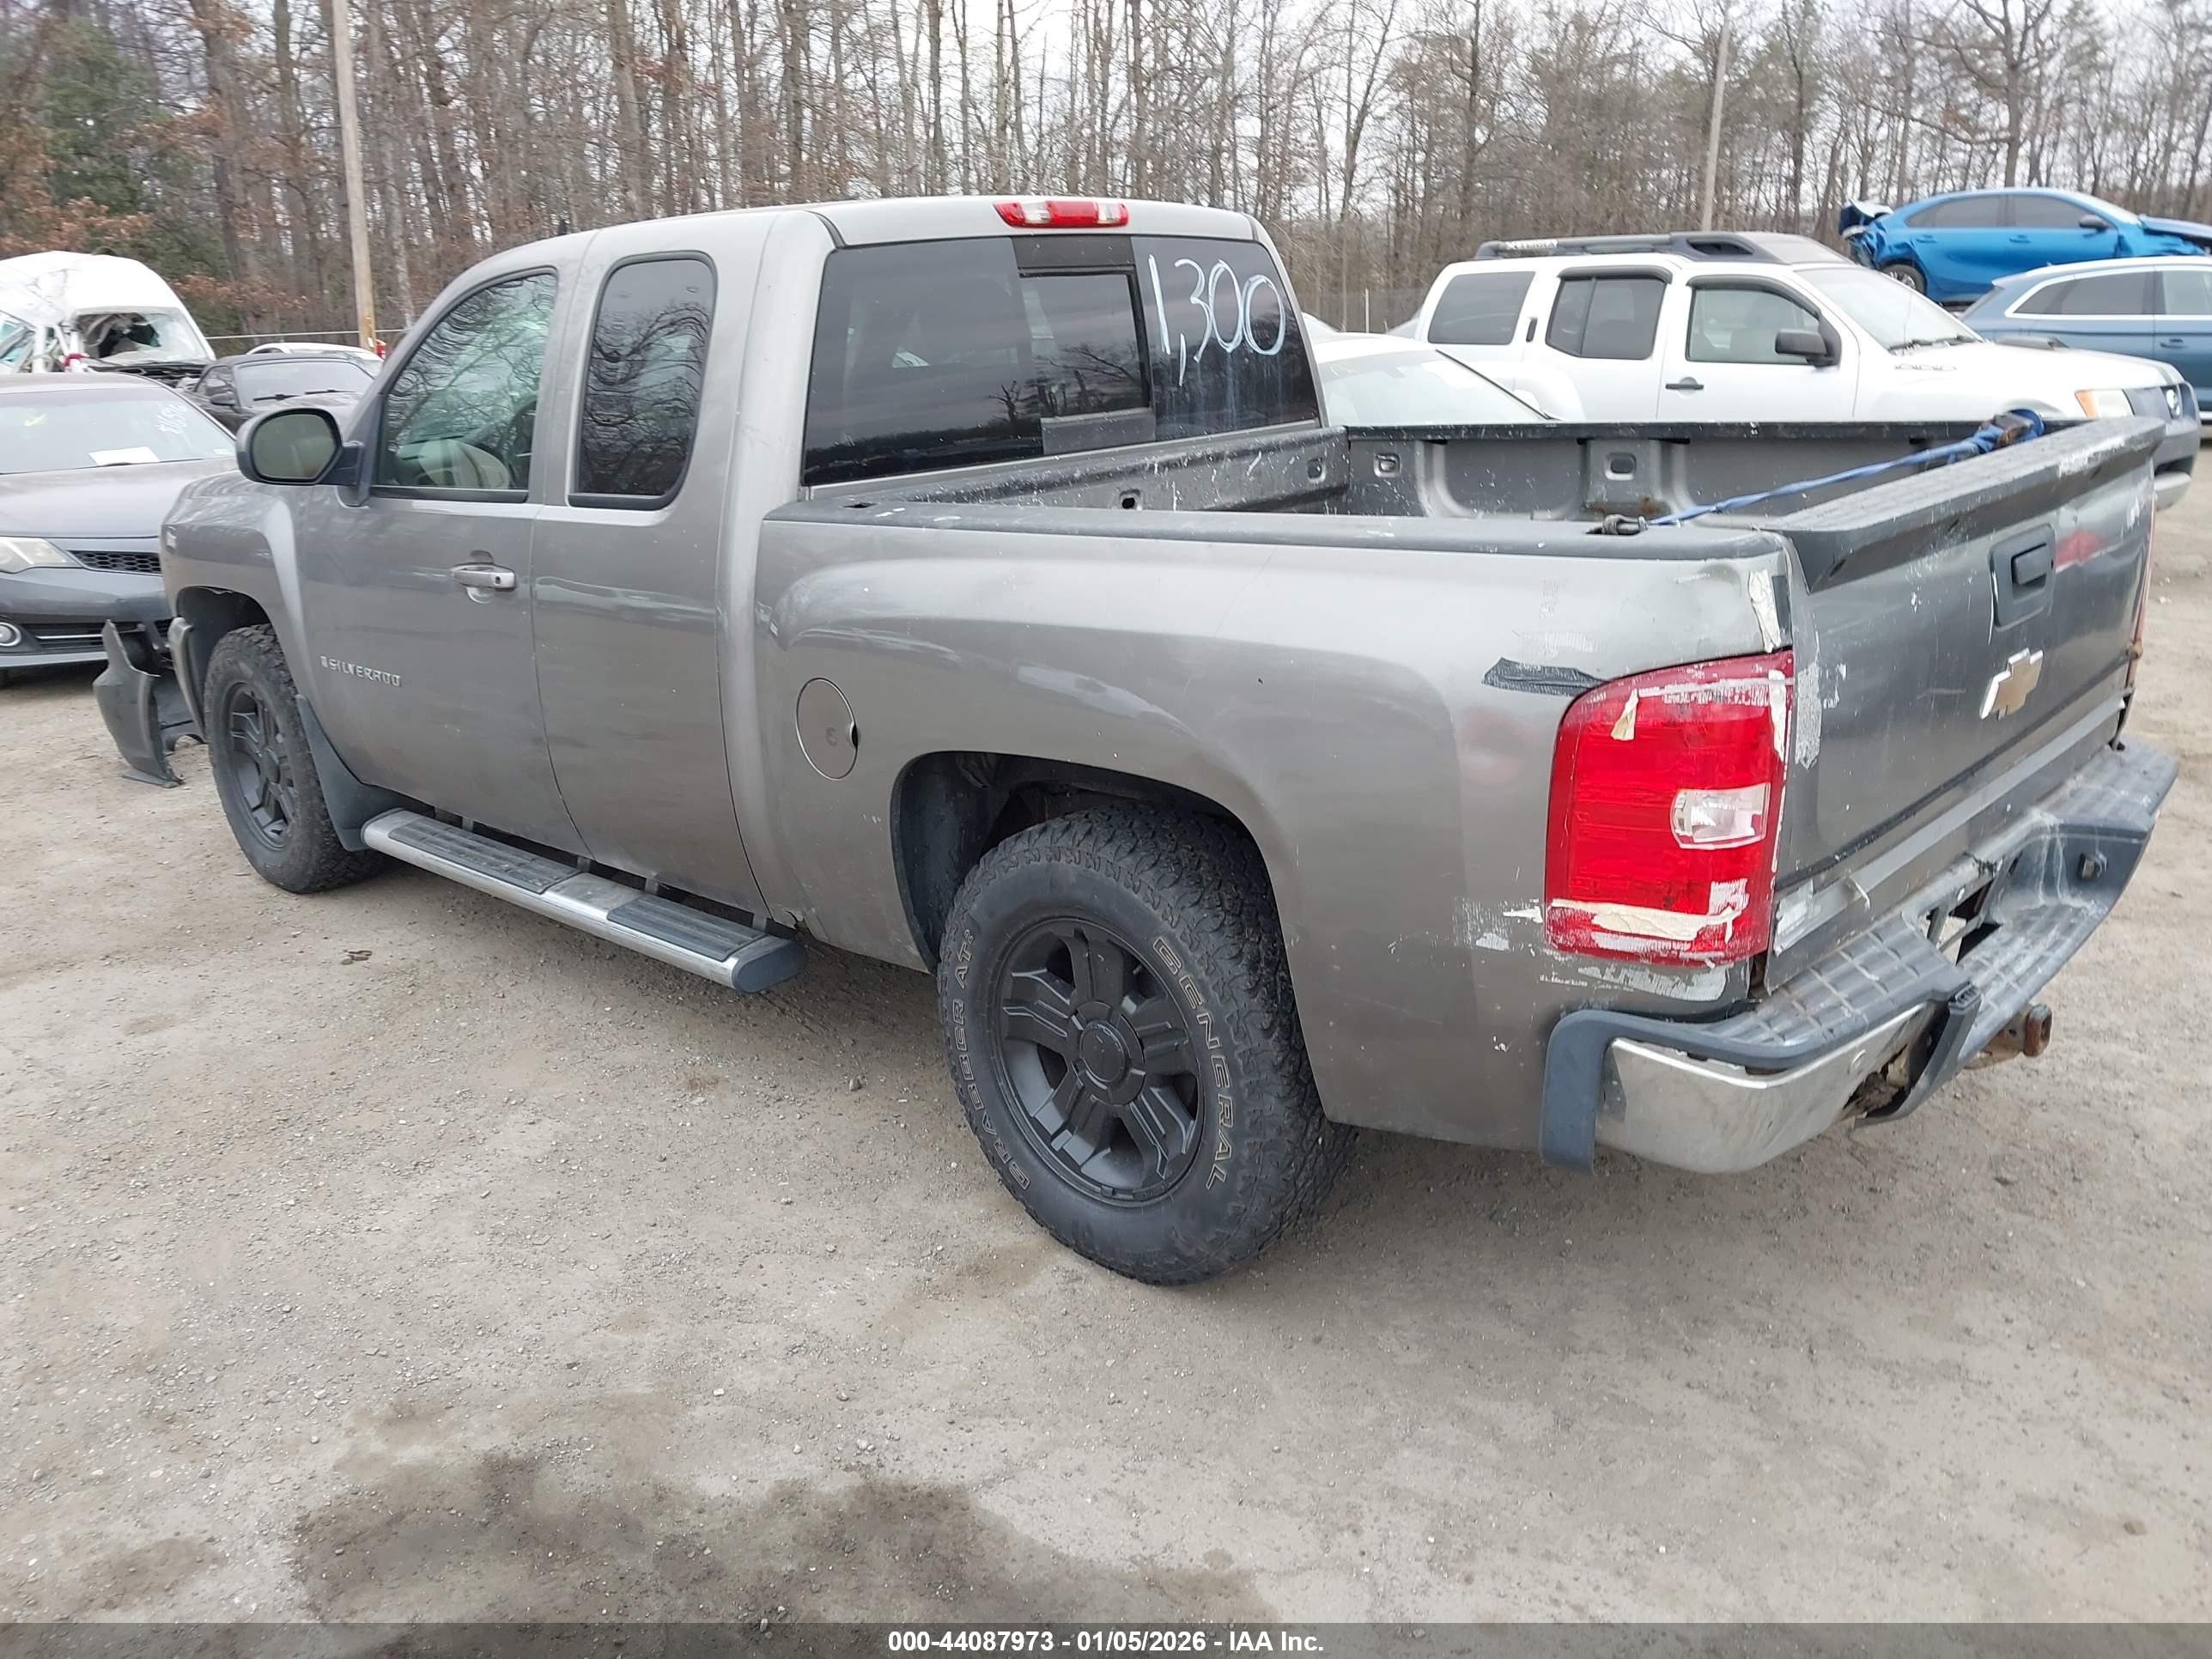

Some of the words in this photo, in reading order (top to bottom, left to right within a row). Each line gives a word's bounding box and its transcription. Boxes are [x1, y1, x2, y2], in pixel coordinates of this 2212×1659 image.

[1148, 254, 1286, 386] 1,300
[328, 658, 401, 687] SILVERADO
[952, 999, 1030, 1190] GRABBER
[1152, 937, 1235, 1191] GENERAL
